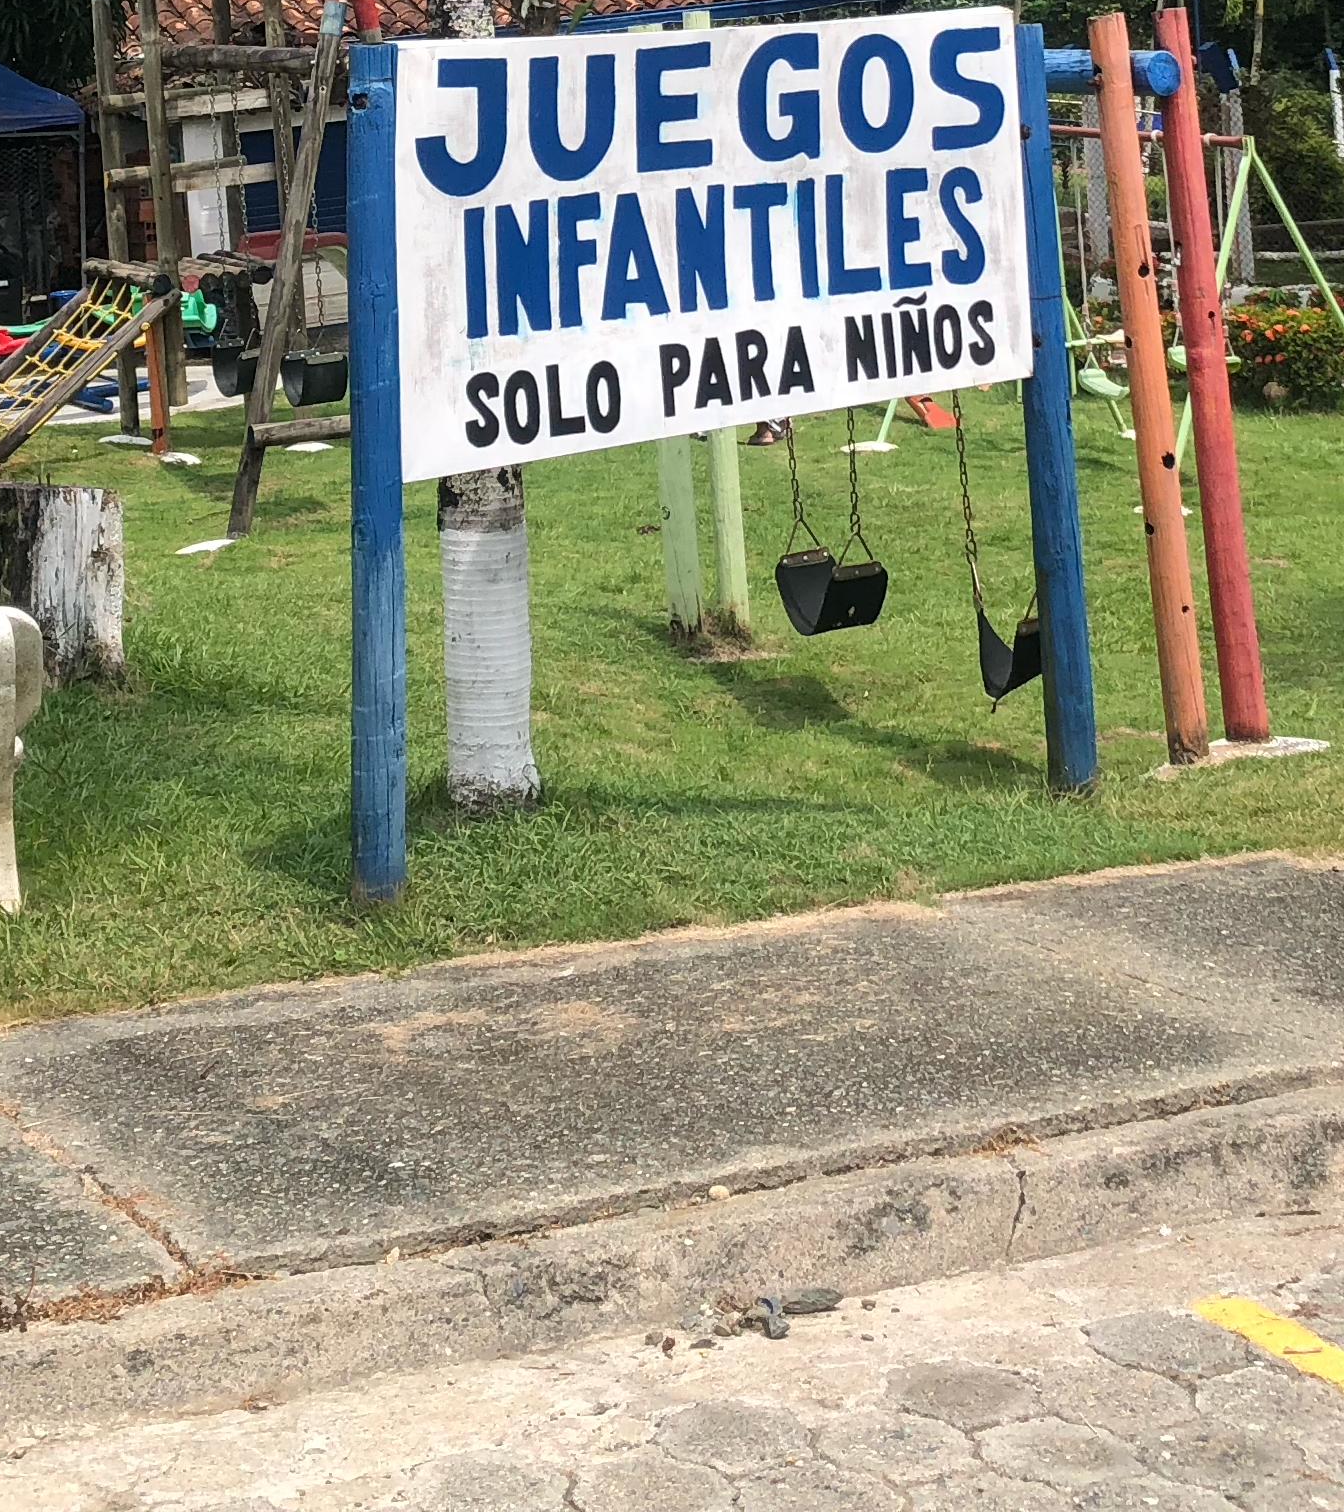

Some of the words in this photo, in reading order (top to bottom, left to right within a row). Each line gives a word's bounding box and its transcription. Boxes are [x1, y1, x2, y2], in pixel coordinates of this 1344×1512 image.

[415, 27, 1005, 196] JUEGOS
[463, 167, 985, 339] INFANTILES
[465, 360, 621, 448] SOLO
[659, 325, 815, 417] PARA
[845, 291, 996, 382] NIÑOS
